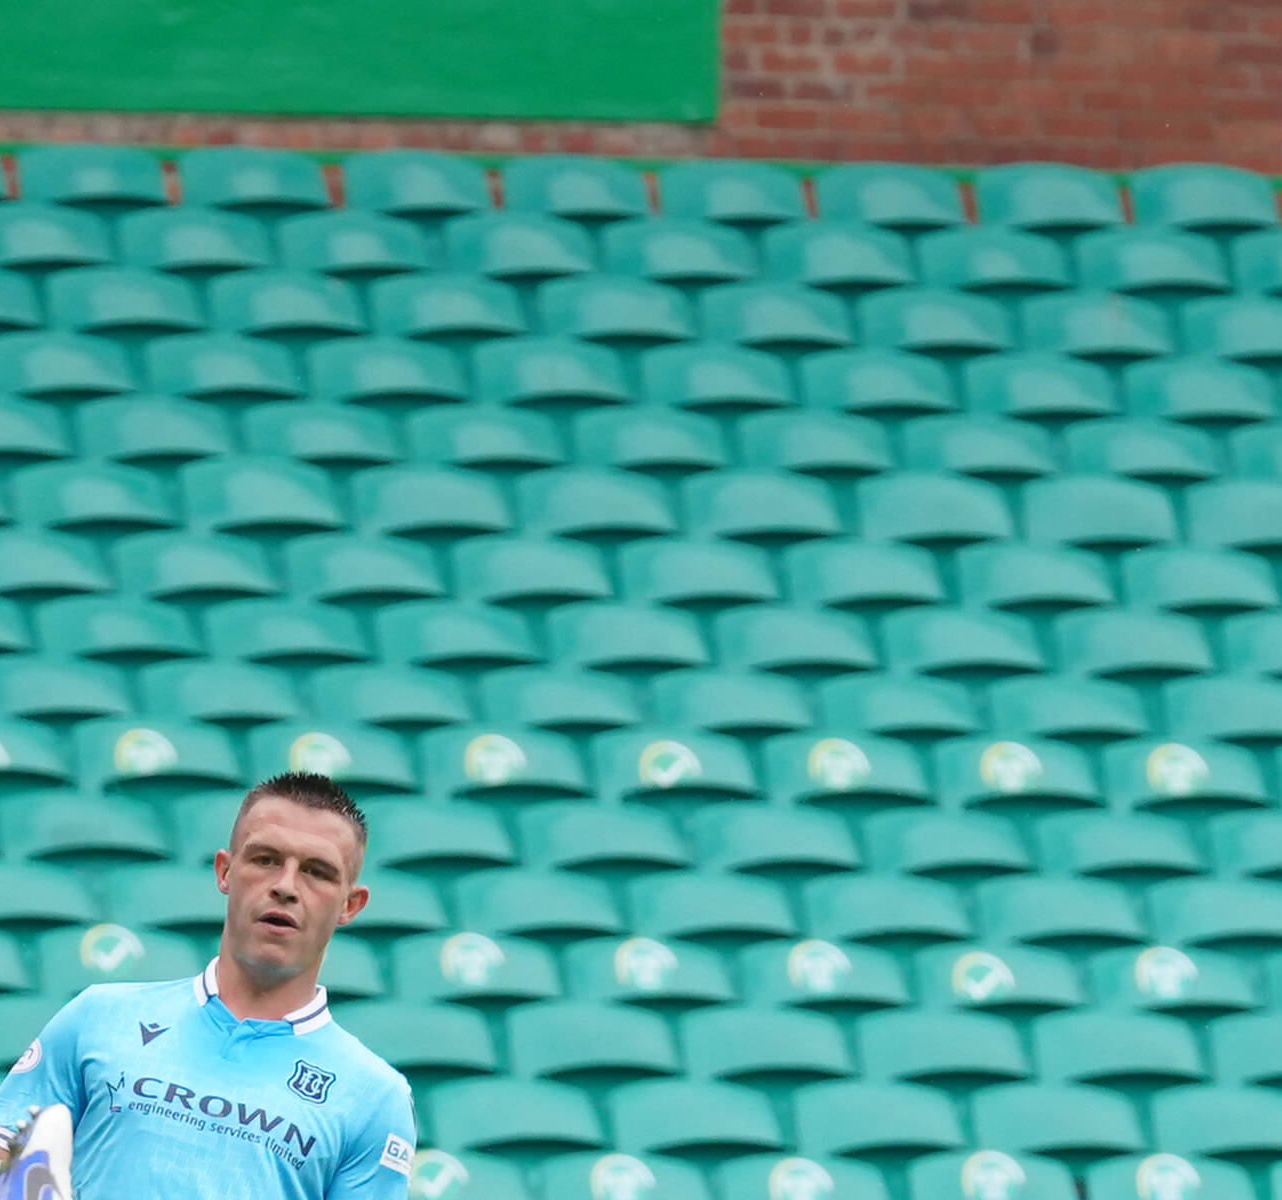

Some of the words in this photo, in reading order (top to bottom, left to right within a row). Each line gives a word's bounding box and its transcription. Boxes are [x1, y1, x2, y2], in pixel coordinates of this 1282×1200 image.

[128, 1099, 207, 1131] engineering
[210, 1121, 262, 1144] services
[264, 1136, 306, 1171] limited
[133, 1077, 317, 1157] CROWN
